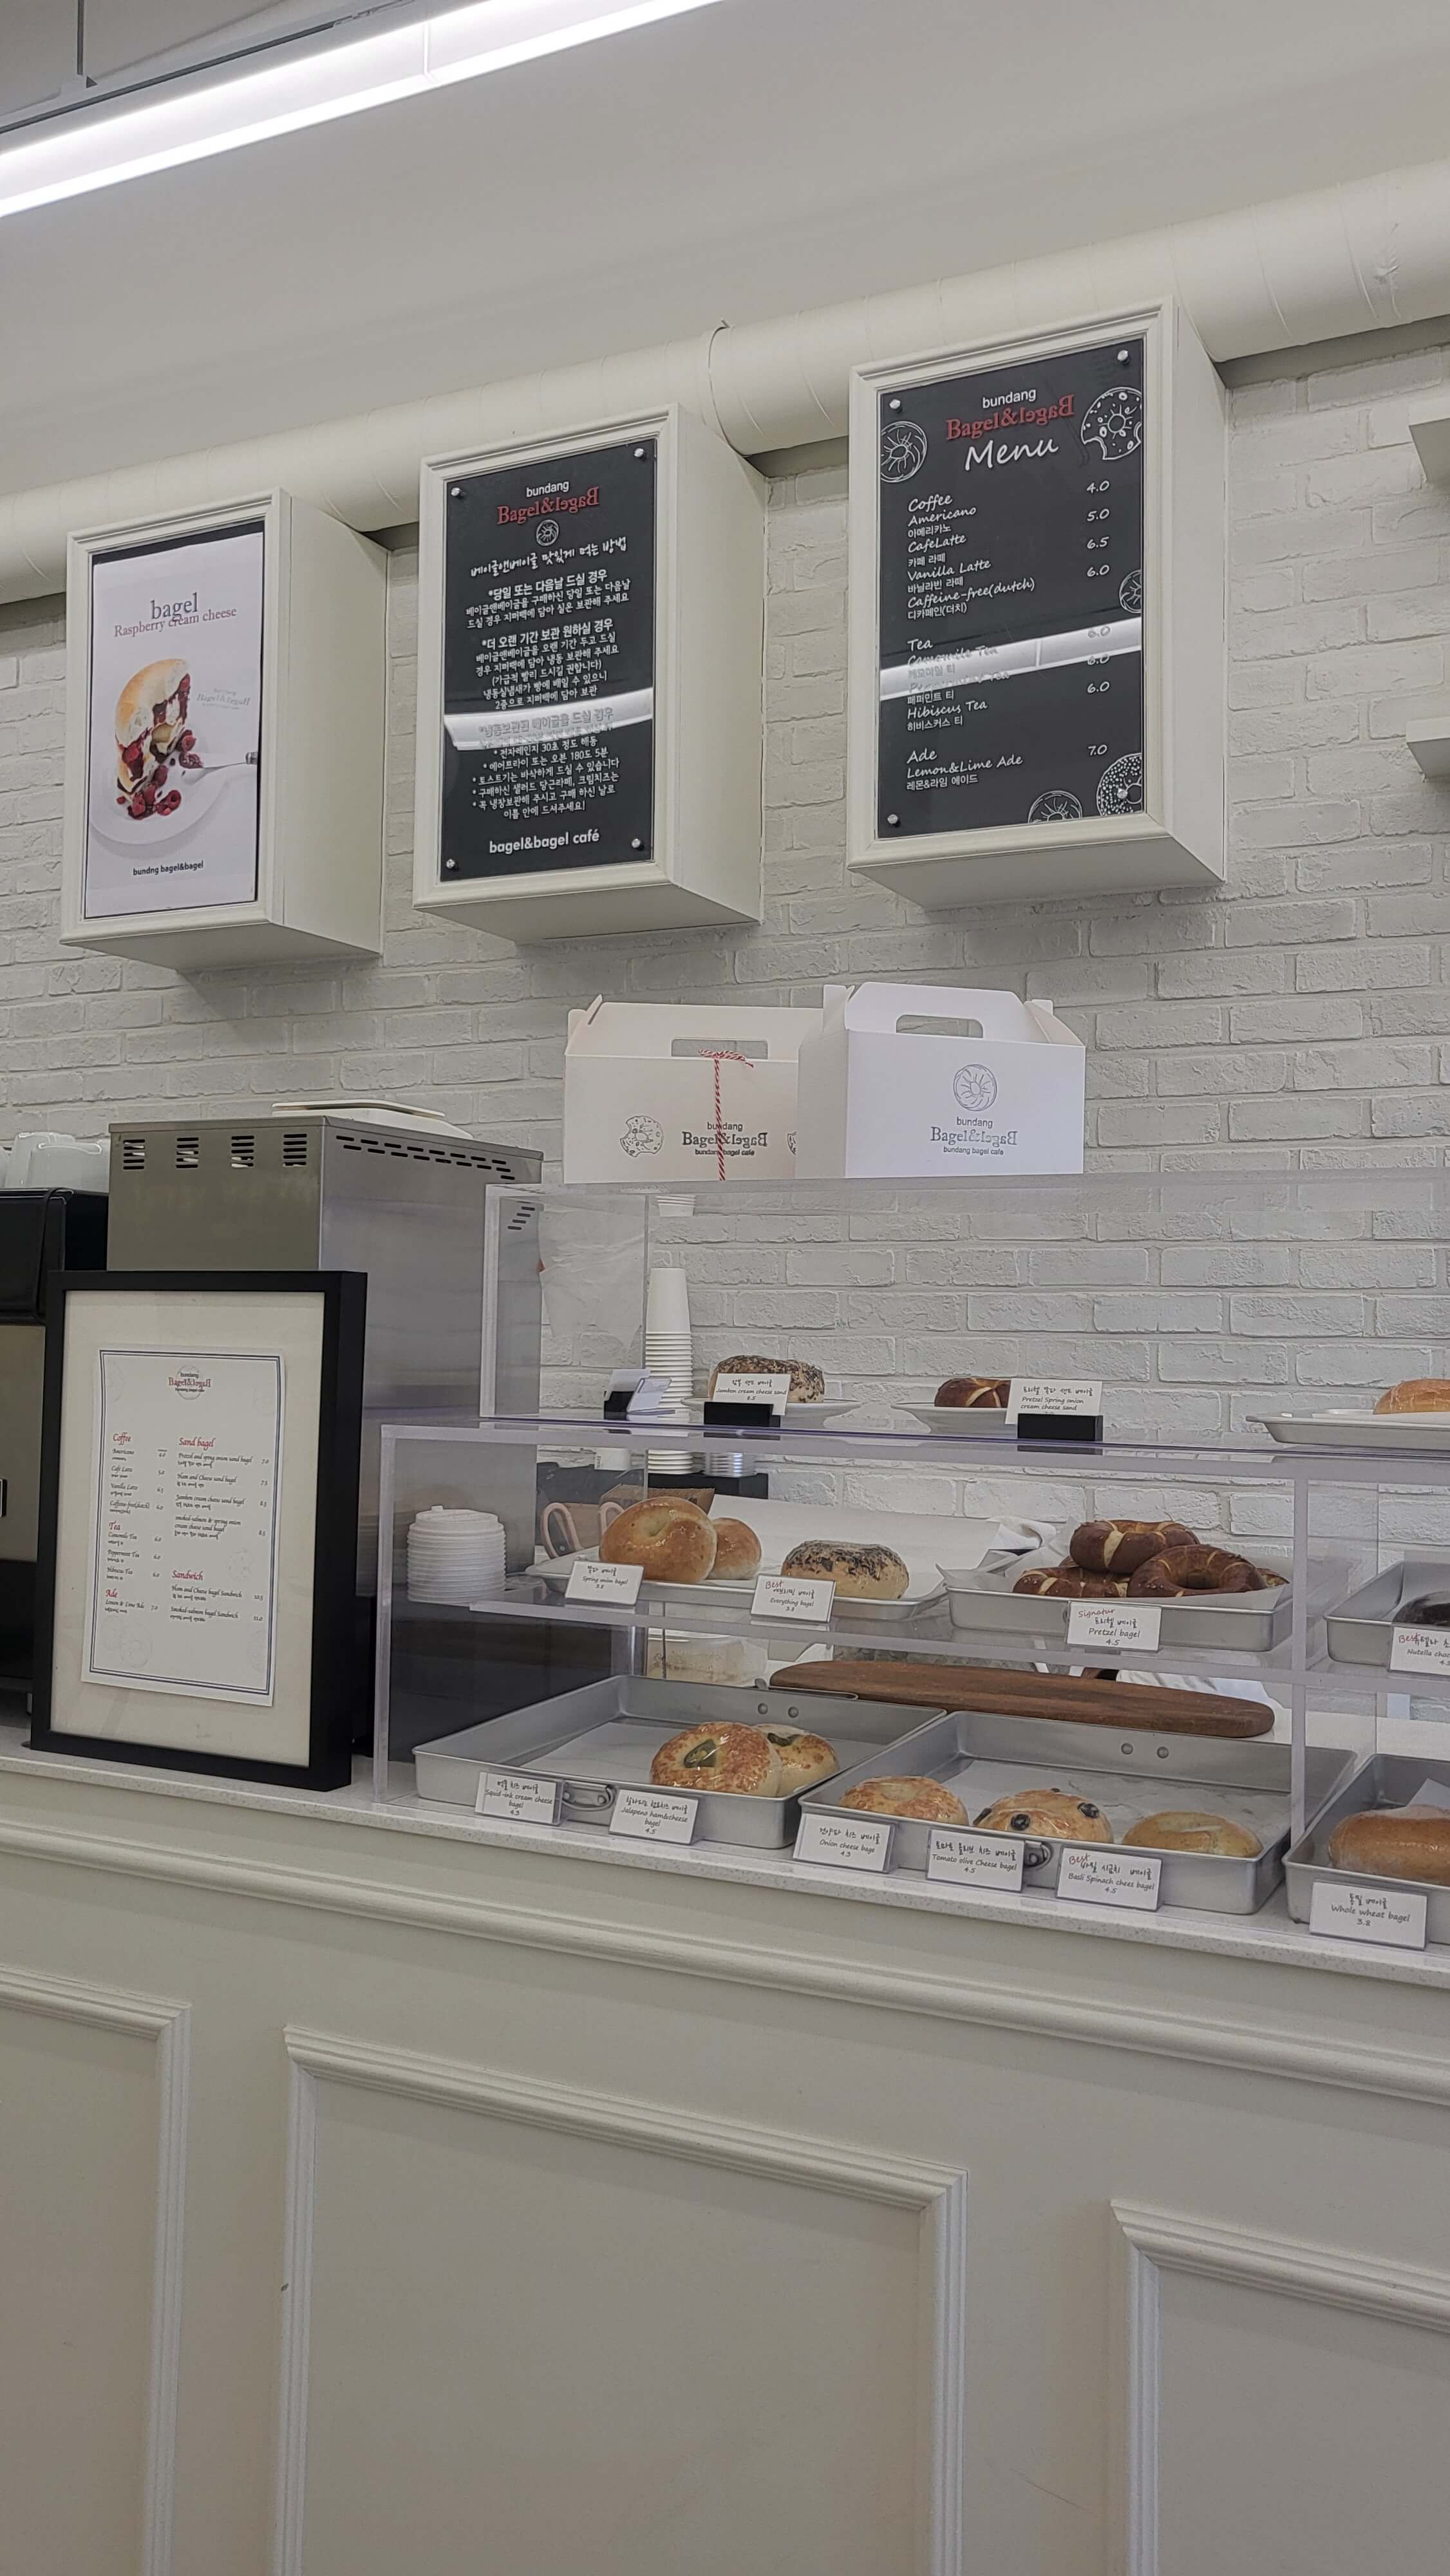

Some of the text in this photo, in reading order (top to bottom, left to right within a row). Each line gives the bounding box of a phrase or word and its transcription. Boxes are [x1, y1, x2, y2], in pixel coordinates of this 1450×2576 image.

[983, 390, 1036, 408] bundang
[965, 440, 1059, 469] Menu
[1087, 480, 1109, 493] 4.0
[909, 495, 952, 511] Coffee
[908, 507, 976, 526] Americano
[1087, 509, 1109, 521] 5.0
[908, 524, 953, 538] 아메리카노
[1087, 536, 1109, 549] 6.5
[541, 549, 574, 564] 맛있게
[579, 544, 599, 556] 먹는
[603, 537, 626, 553] 방법
[928, 553, 945, 564] 라떼
[907, 560, 991, 580] Vanilla Latte
[1087, 565, 1109, 576] 6.0
[946, 576, 963, 587] 라떼
[151, 592, 198, 620] bagel
[908, 602, 968, 619] 디카페인(더치)
[114, 607, 237, 638] Raspberry cream cheese
[907, 639, 933, 650] Tea
[1088, 681, 1109, 693] 6.0
[946, 690, 954, 699] 티
[908, 701, 987, 719] Hibiscus Tea
[907, 715, 963, 731] 히비스커스 티
[907, 748, 937, 763] Ade
[1088, 744, 1107, 755] 7.0
[907, 755, 1022, 778] Lemon&Lime Ade
[907, 775, 978, 790] 레몬&라임 에이드
[160, 861, 203, 873] bagel&bagel
[957, 1117, 993, 1129] bundang
[1069, 1853, 1090, 1865] Best
